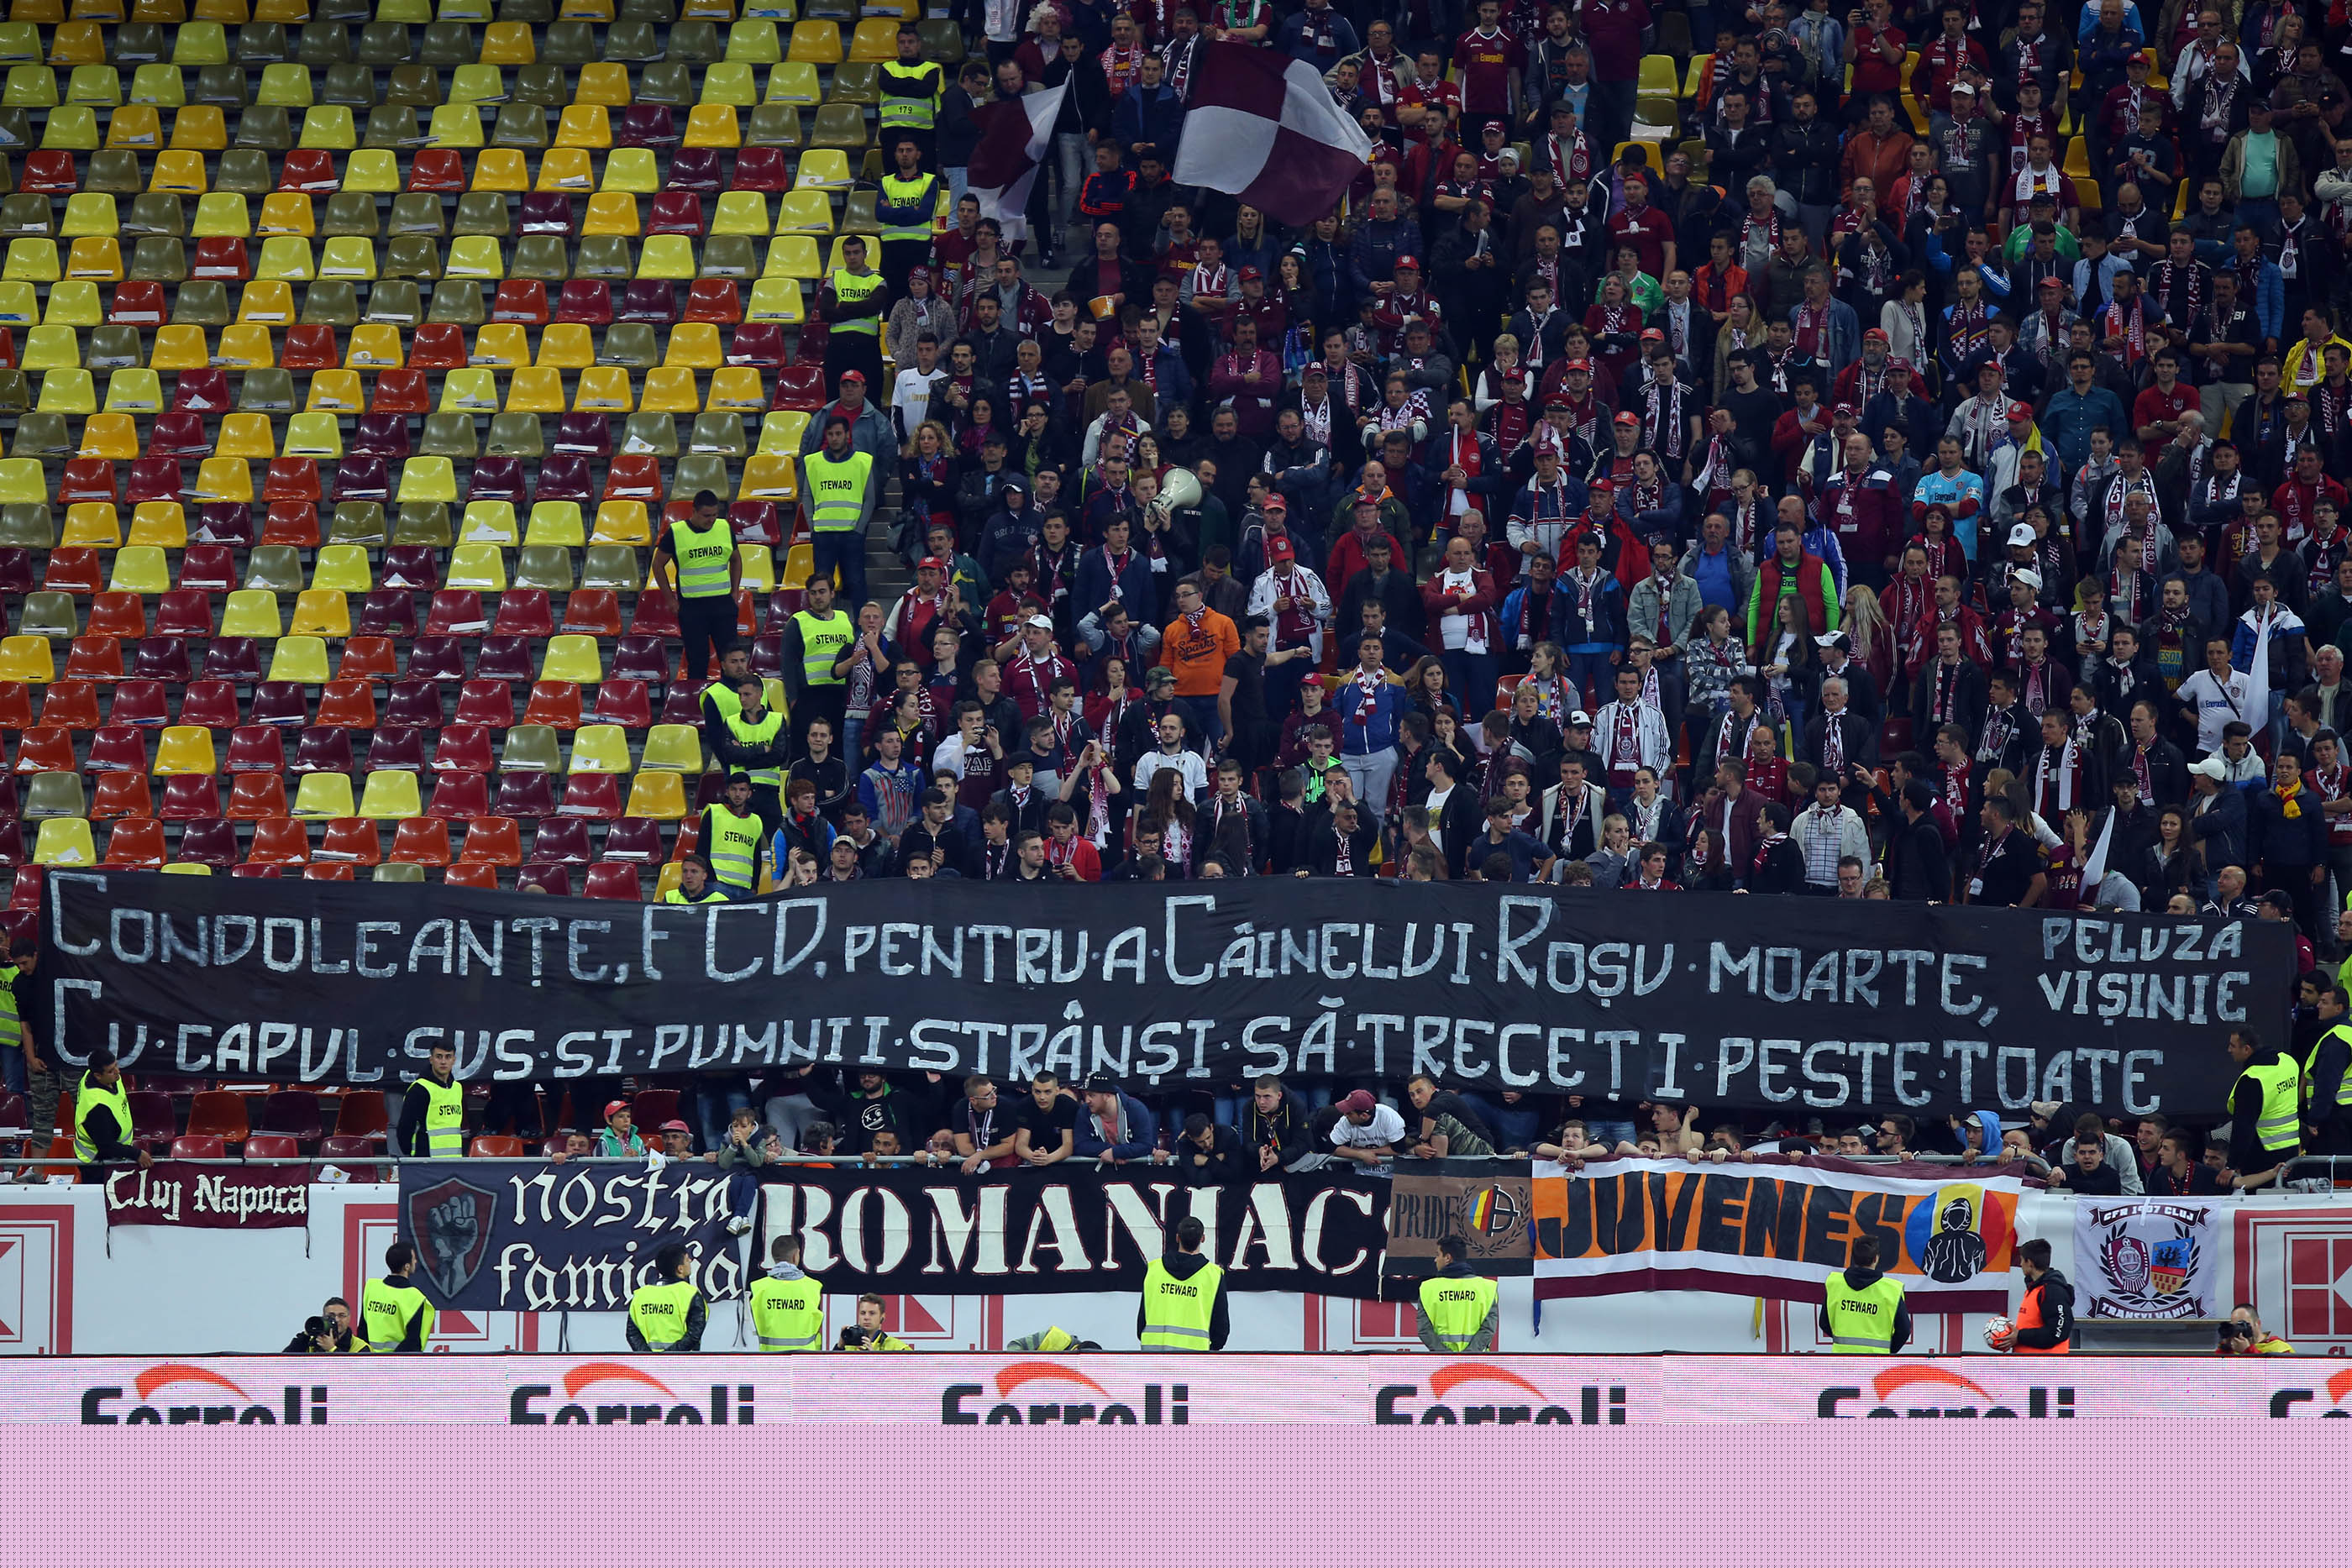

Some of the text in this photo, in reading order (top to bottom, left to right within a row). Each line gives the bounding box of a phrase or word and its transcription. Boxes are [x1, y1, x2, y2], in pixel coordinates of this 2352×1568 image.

[893, 197, 921, 208] TEWARD
[841, 288, 871, 298] STEWARD
[2232, 311, 2245, 321] BI
[820, 479, 853, 491] STEWARD
[688, 545, 724, 559] STEWARD
[815, 632, 848, 645] STEWARD
[1178, 632, 1217, 658] Sparks
[723, 830, 755, 847] STEWARD
[2043, 917, 2243, 963] PELUZA
[1102, 927, 1146, 983] A
[1717, 1036, 1931, 1108] PESTE
[1943, 1039, 2164, 1116] TOATE
[2276, 1076, 2297, 1095] STEWARD
[438, 1104, 462, 1117] STEWARD
[105, 1168, 307, 1225] Cluj Napoca
[507, 1166, 732, 1235] nostra
[1394, 1193, 1460, 1240] PRIDE
[1538, 1171, 1907, 1273] JUVENES
[2103, 1207, 2129, 1222] CFR
[2164, 1205, 2194, 1222] CLUJ
[758, 1181, 1391, 1276] ROMANIAC
[493, 1240, 743, 1312] famiia
[1160, 1282, 1198, 1298] STEWARD
[1438, 1290, 1476, 1302] STEWARD
[367, 1299, 397, 1316] STEWARD
[641, 1303, 675, 1316] STEWARD
[766, 1298, 806, 1310] STEWARD
[1840, 1298, 1878, 1315] STEWARD
[2101, 1302, 2195, 1319] TRANSYLVANIA
